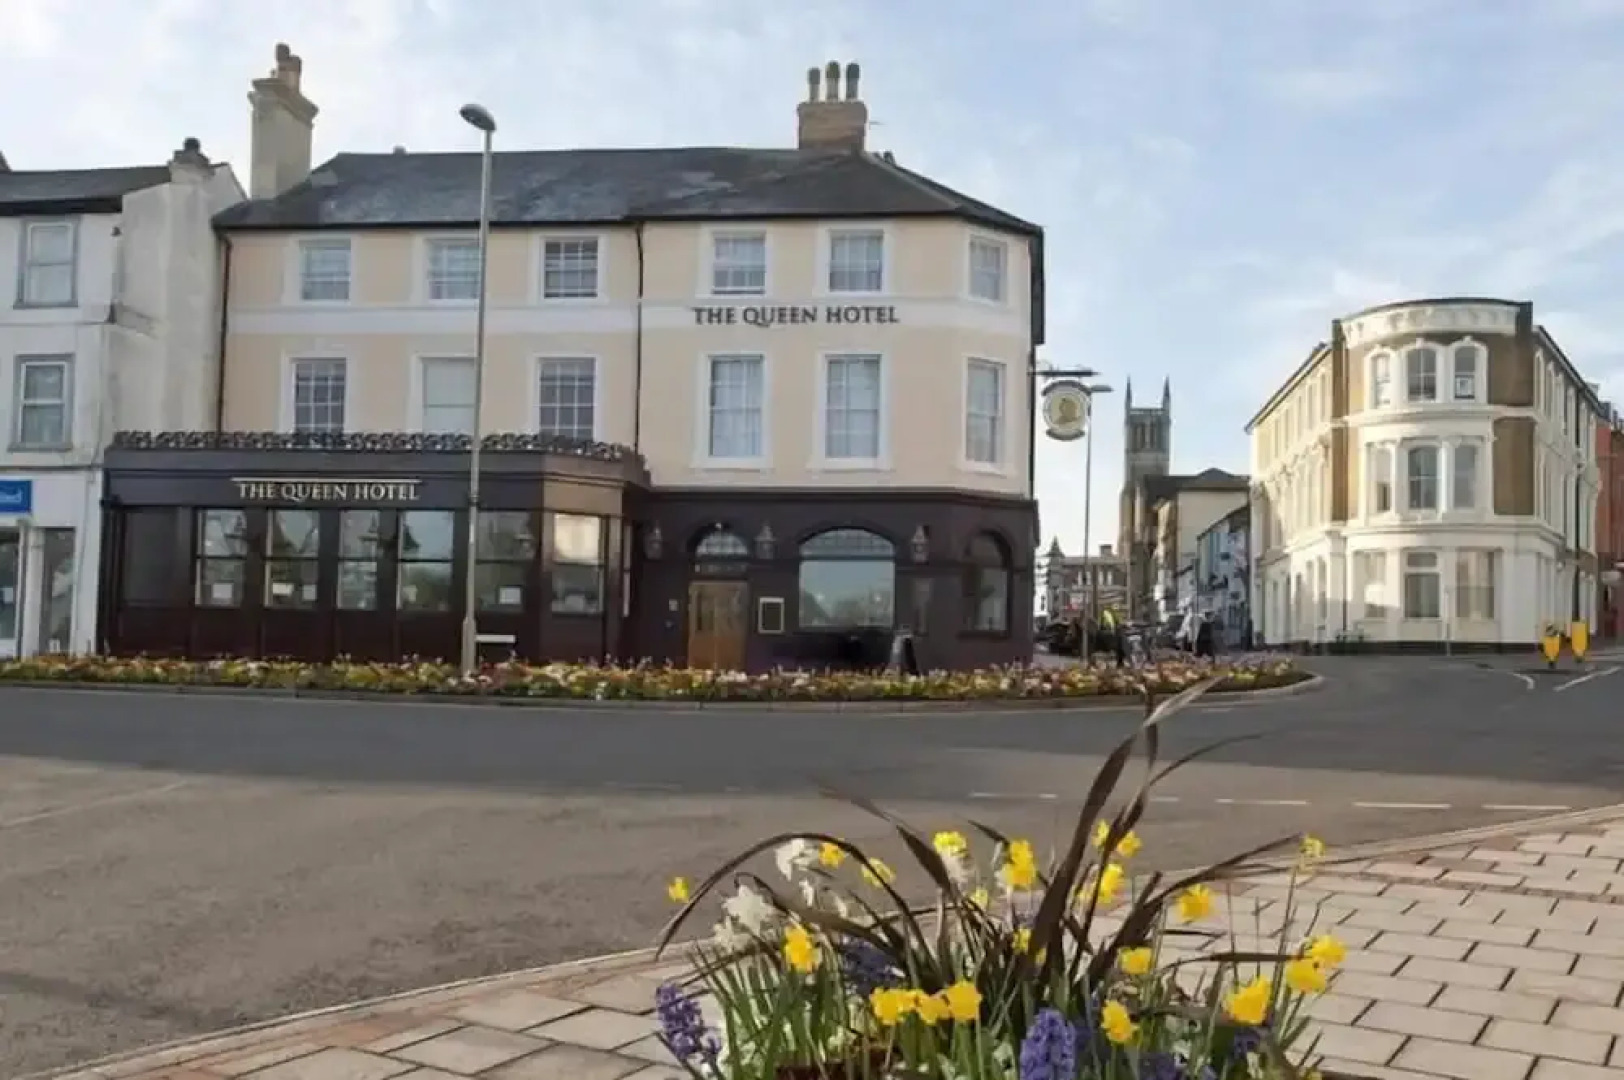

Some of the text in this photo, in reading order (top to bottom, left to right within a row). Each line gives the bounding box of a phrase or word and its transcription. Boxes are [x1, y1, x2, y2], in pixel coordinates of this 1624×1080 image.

[692, 306, 900, 328] THE QUEEN HOTEL
[237, 483, 420, 502] THE QUEEN HOTEL
